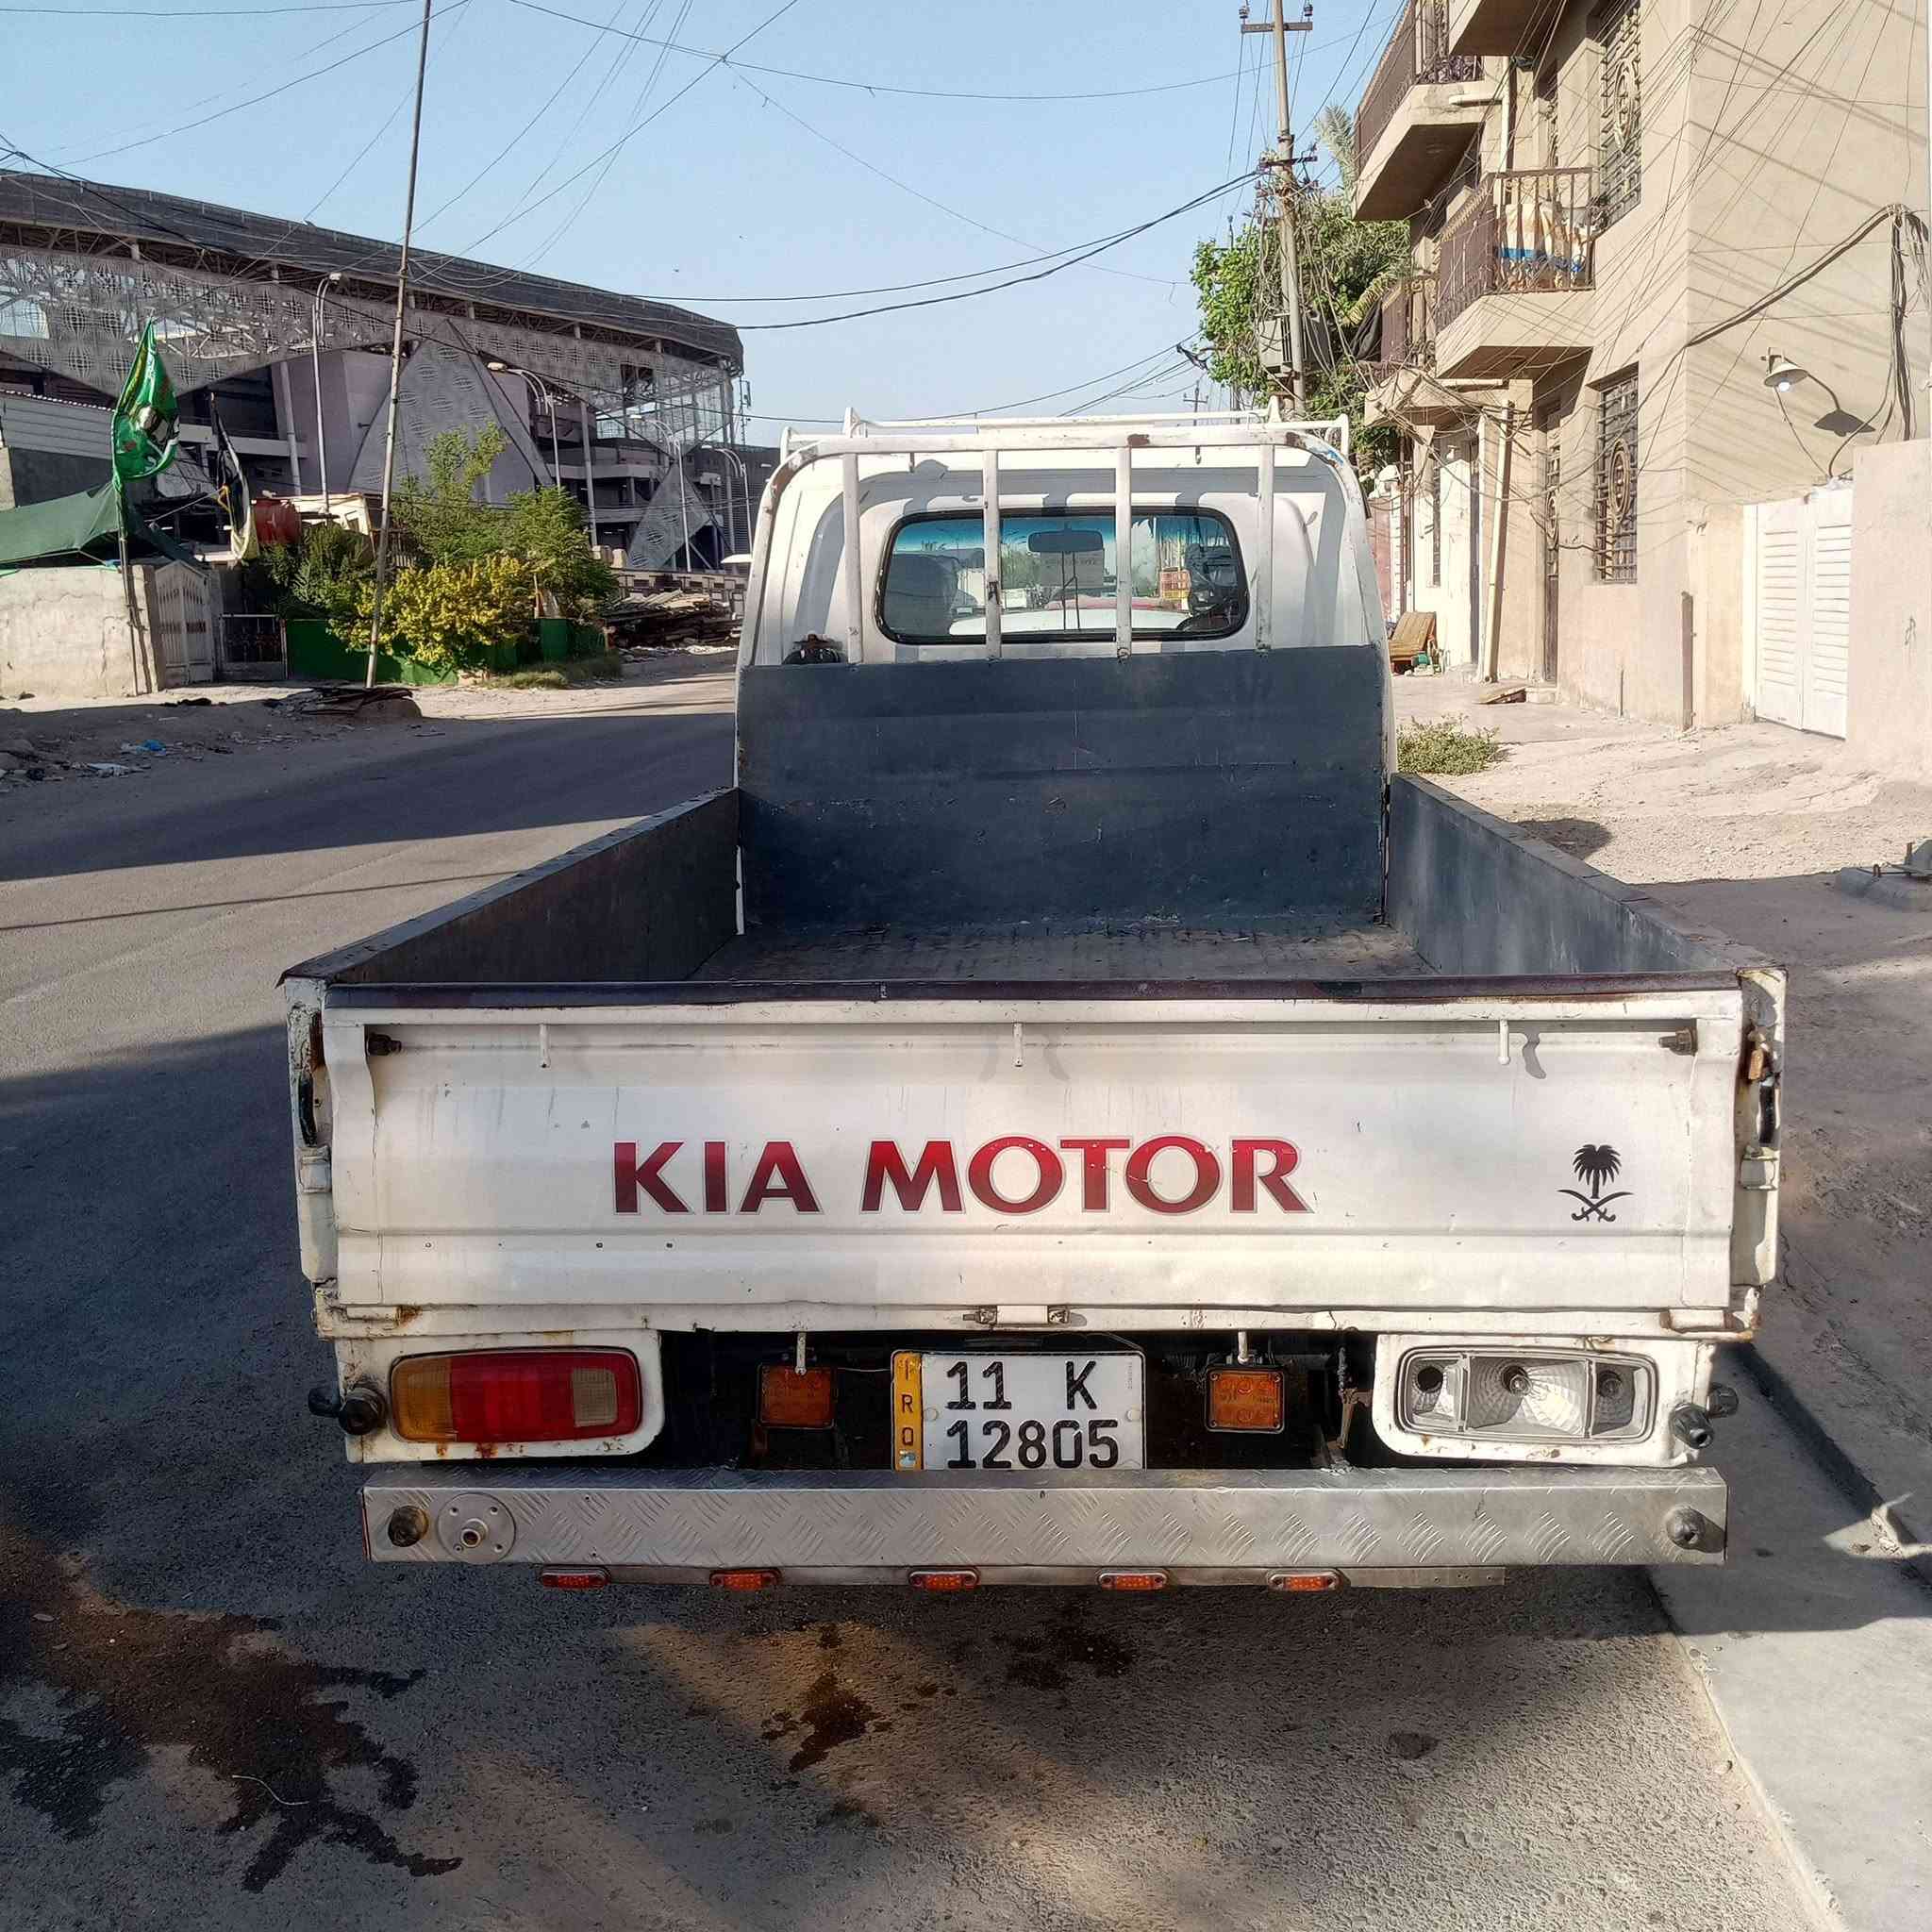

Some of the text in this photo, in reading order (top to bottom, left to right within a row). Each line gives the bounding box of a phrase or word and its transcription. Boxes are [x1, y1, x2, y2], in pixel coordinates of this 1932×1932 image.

[613, 1134, 1315, 1215] KIA MOTOR
[946, 1360, 1012, 1410] 11
[1065, 1360, 1098, 1410] K
[946, 1419, 1120, 1469] 12805
